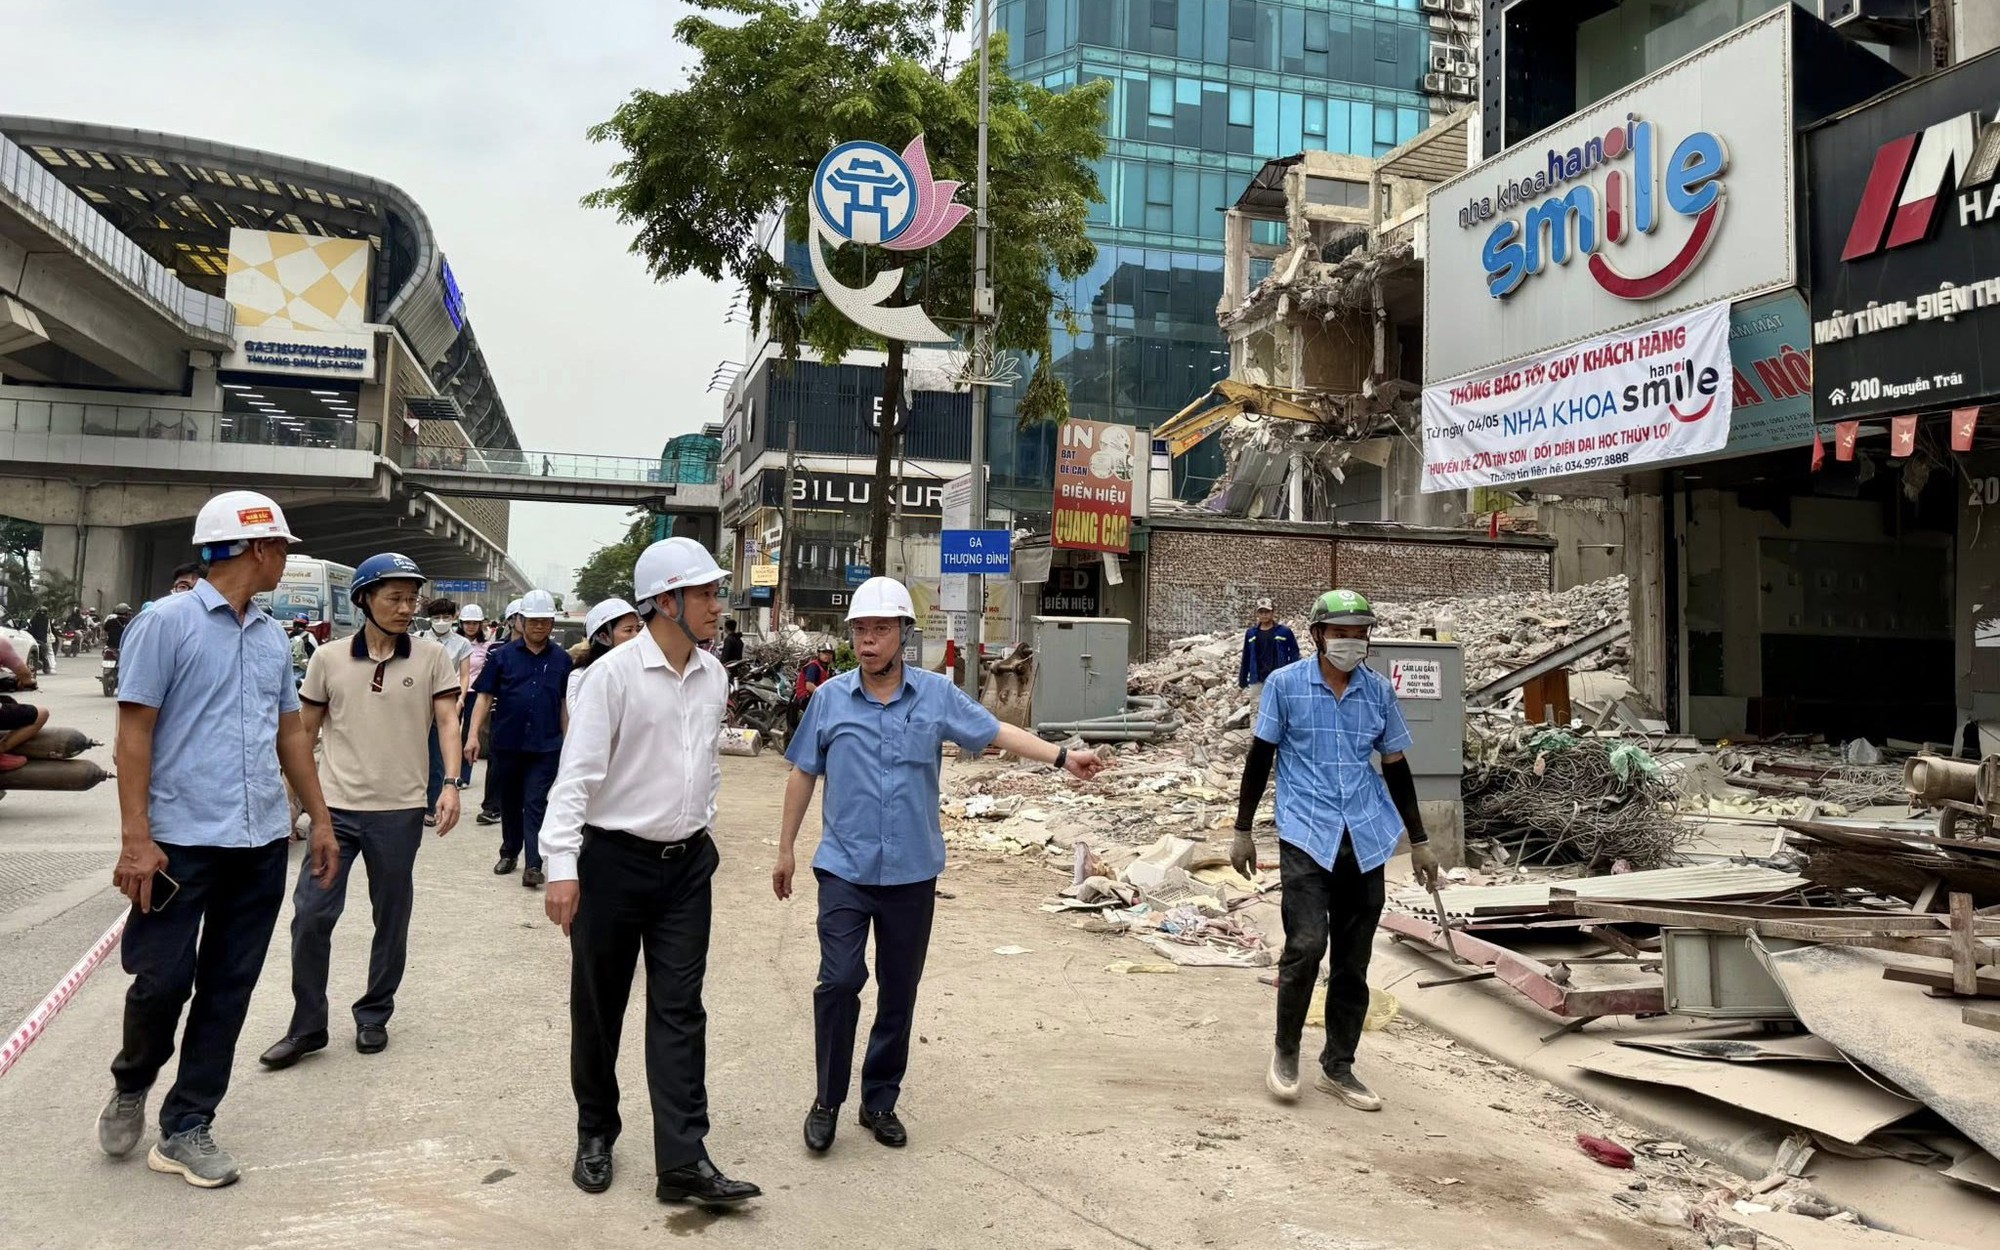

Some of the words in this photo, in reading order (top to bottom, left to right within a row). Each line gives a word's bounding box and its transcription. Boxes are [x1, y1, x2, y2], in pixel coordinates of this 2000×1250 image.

[1458, 196, 1491, 229] nha
[1482, 120, 1730, 299] smile
[320, 360, 364, 371] STATION
[1449, 381, 1491, 406] THÔNG
[1494, 371, 1521, 396] BÁO
[1548, 351, 1580, 382] QUÝ
[1583, 341, 1634, 373] KHÁCH
[1638, 326, 1686, 359] HÀNG
[1650, 357, 1686, 378] hanoi
[1442, 422, 1465, 440] ngày
[1467, 414, 1499, 433] 04/05
[1503, 406, 1547, 437] NHA
[1552, 390, 1618, 427] KHOA
[1622, 359, 1719, 412] smile
[1851, 377, 1880, 402] 200
[1062, 424, 1093, 449] IN
[1428, 457, 1459, 475] HUYỂN
[1565, 452, 1629, 471] 034.997.8888
[1096, 484, 1126, 506] HIỆU
[1055, 503, 1098, 545] QUẢNG
[1102, 509, 1127, 547] CÁO
[969, 537, 982, 548] GA
[943, 552, 982, 567] THƯỢNG
[986, 551, 1009, 565] ĐÌNH
